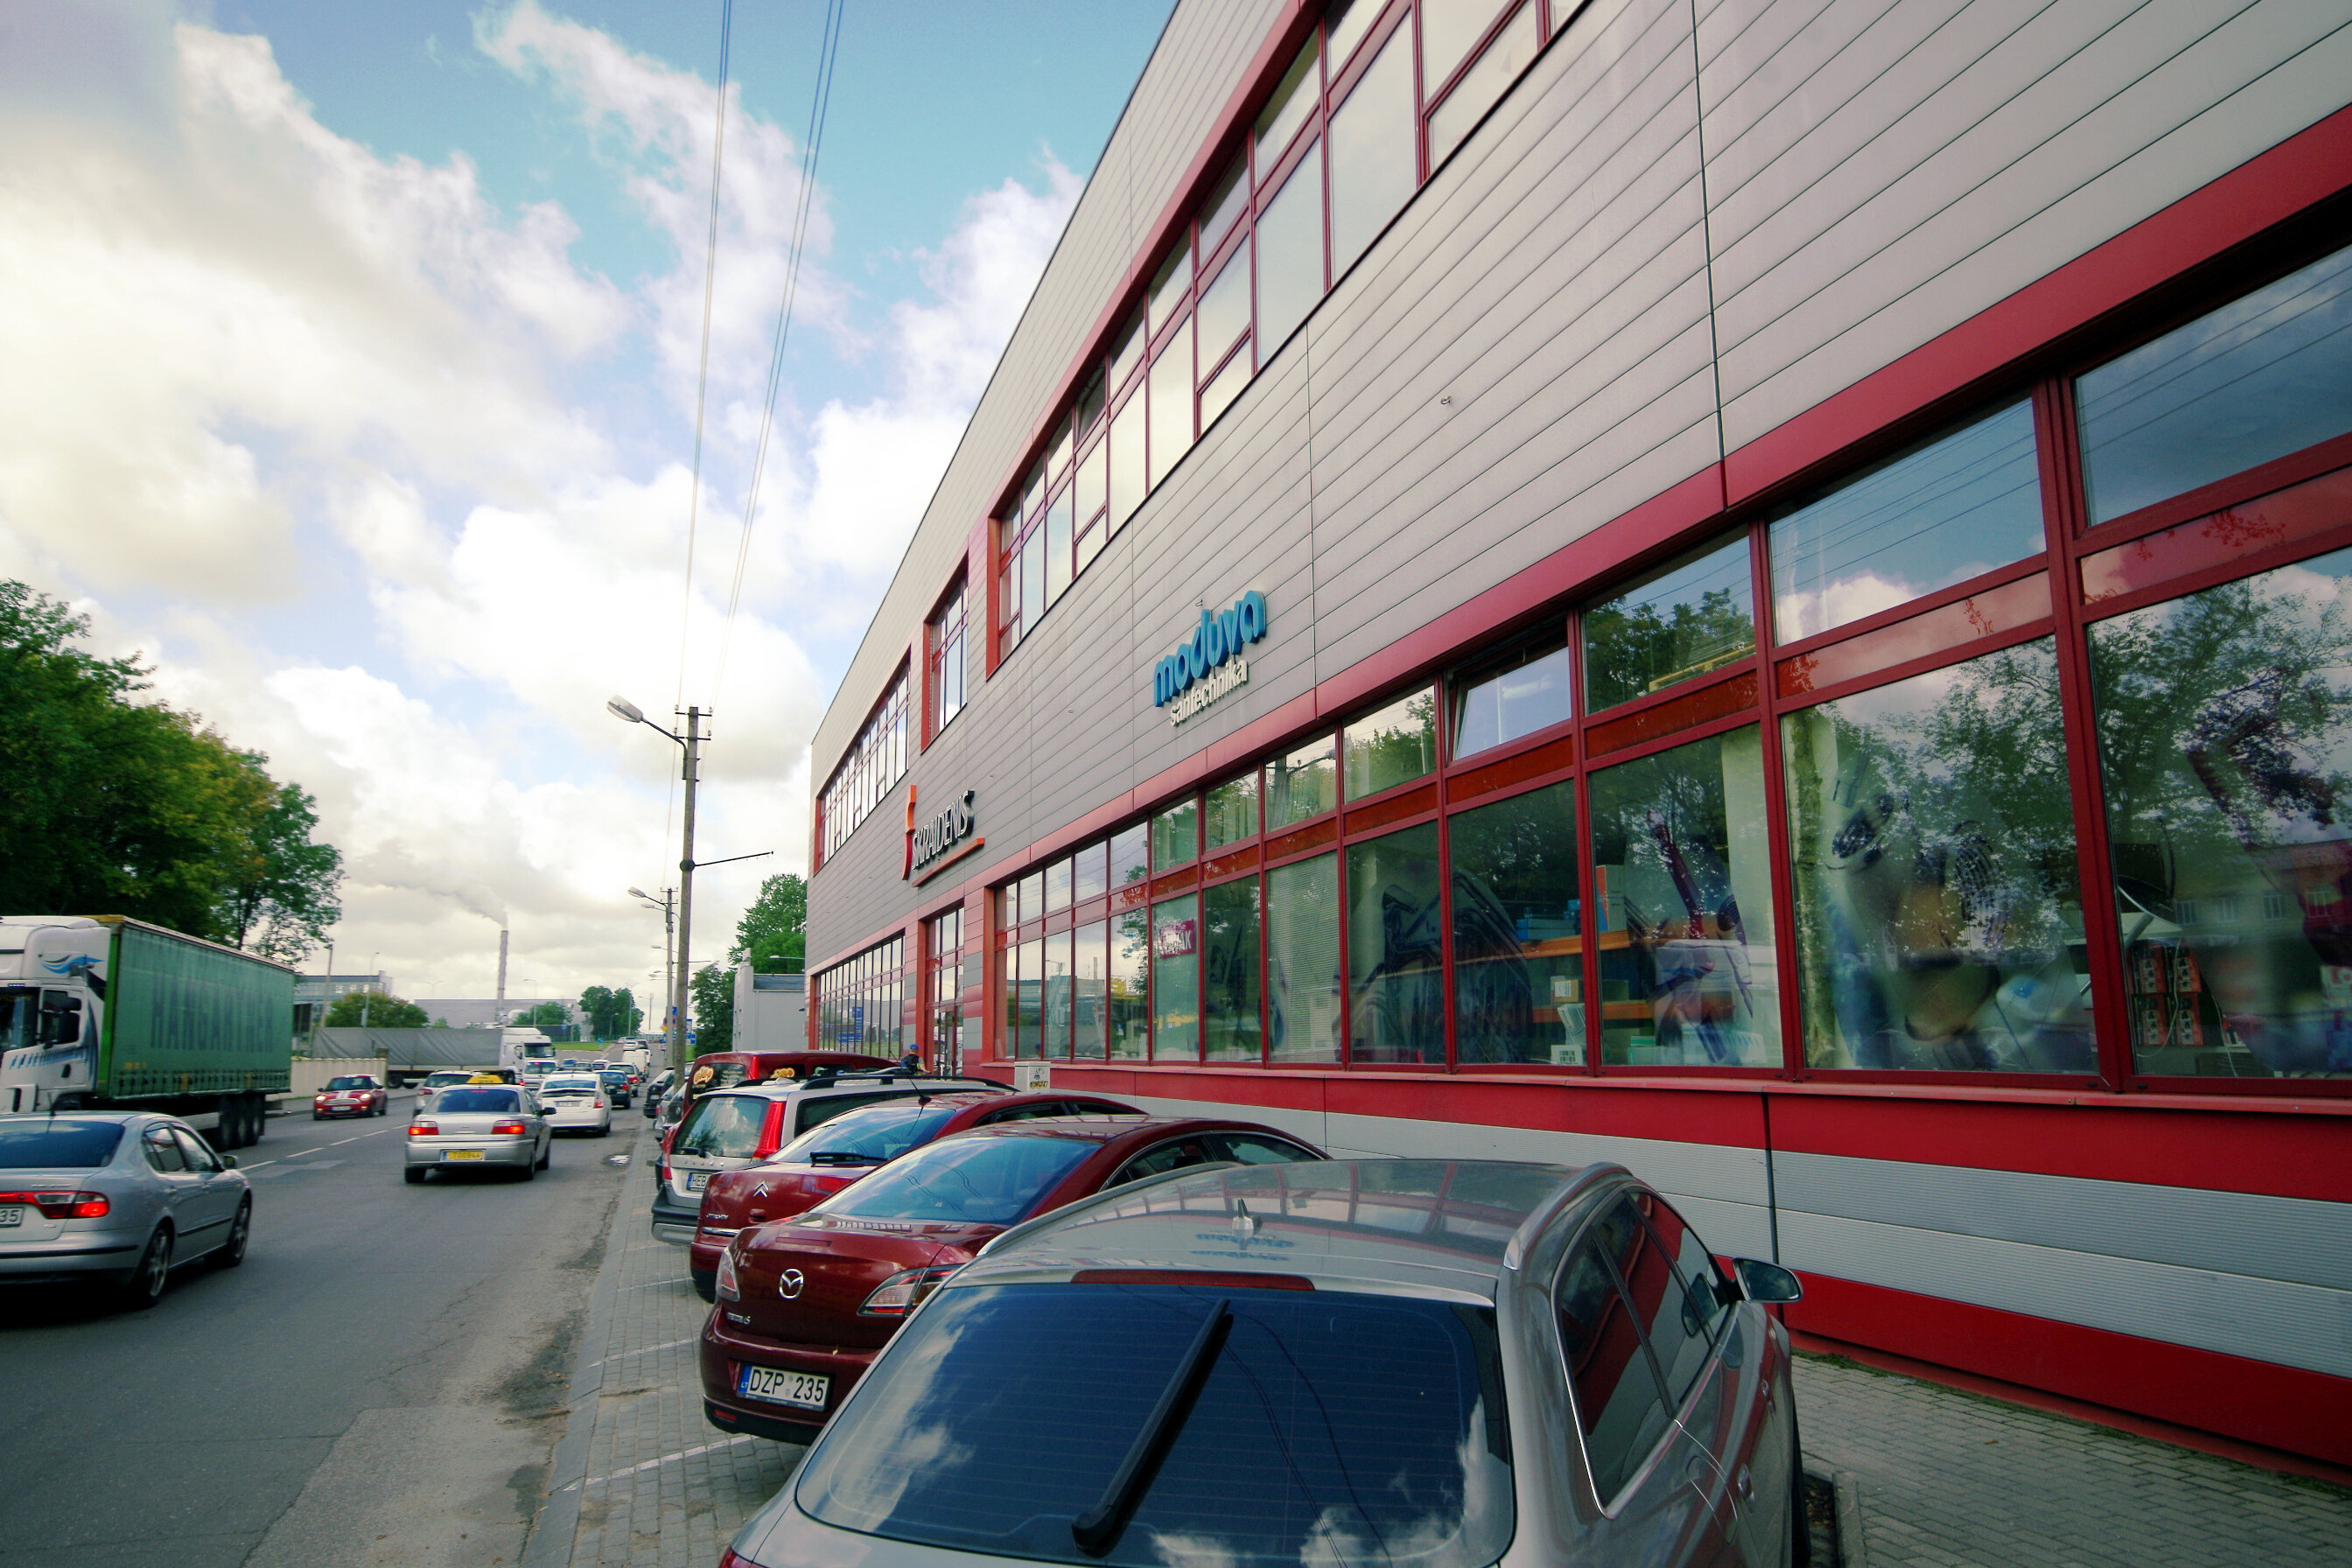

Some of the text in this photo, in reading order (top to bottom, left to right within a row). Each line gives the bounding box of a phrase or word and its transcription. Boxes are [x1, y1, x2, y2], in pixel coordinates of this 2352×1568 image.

[1153, 590, 1267, 707] moduva
[1170, 659, 1249, 727] santechnika
[911, 788, 975, 871] SKRAIDENIS
[750, 1368, 784, 1395] DZP
[793, 1376, 825, 1402] 235
